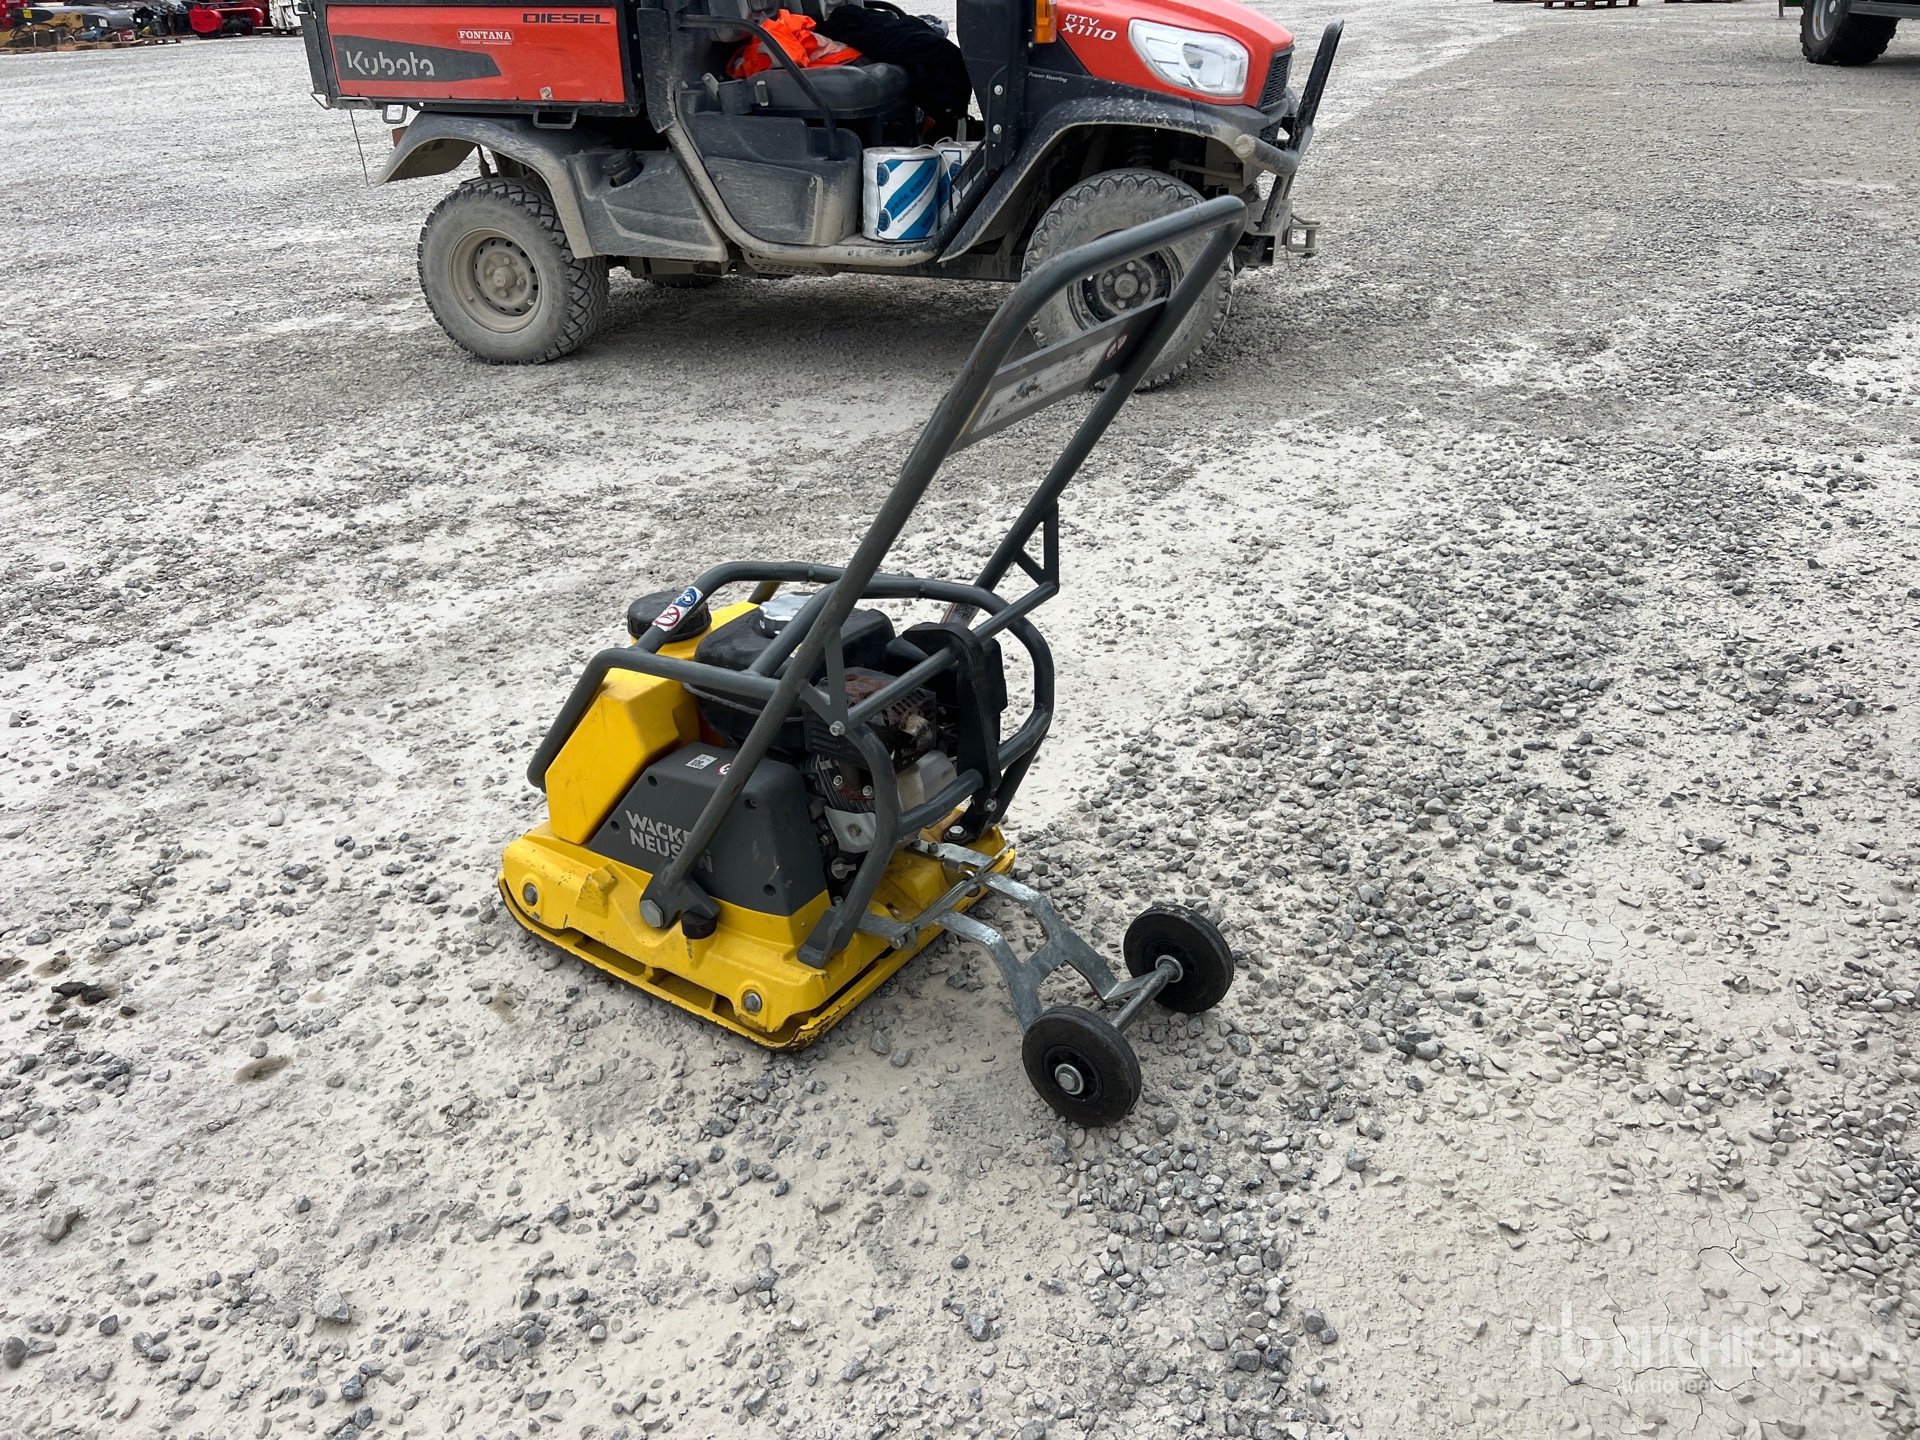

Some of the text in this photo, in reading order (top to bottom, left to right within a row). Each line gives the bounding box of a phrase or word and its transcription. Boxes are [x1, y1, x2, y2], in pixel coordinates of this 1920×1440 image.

[523, 13, 611, 24] DIESEL
[1065, 13, 1100, 26] RTV
[459, 30, 512, 41] FONTANA
[1061, 21, 1118, 41] X1110
[345, 50, 435, 76] Kubota
[625, 809, 695, 847] WACKE
